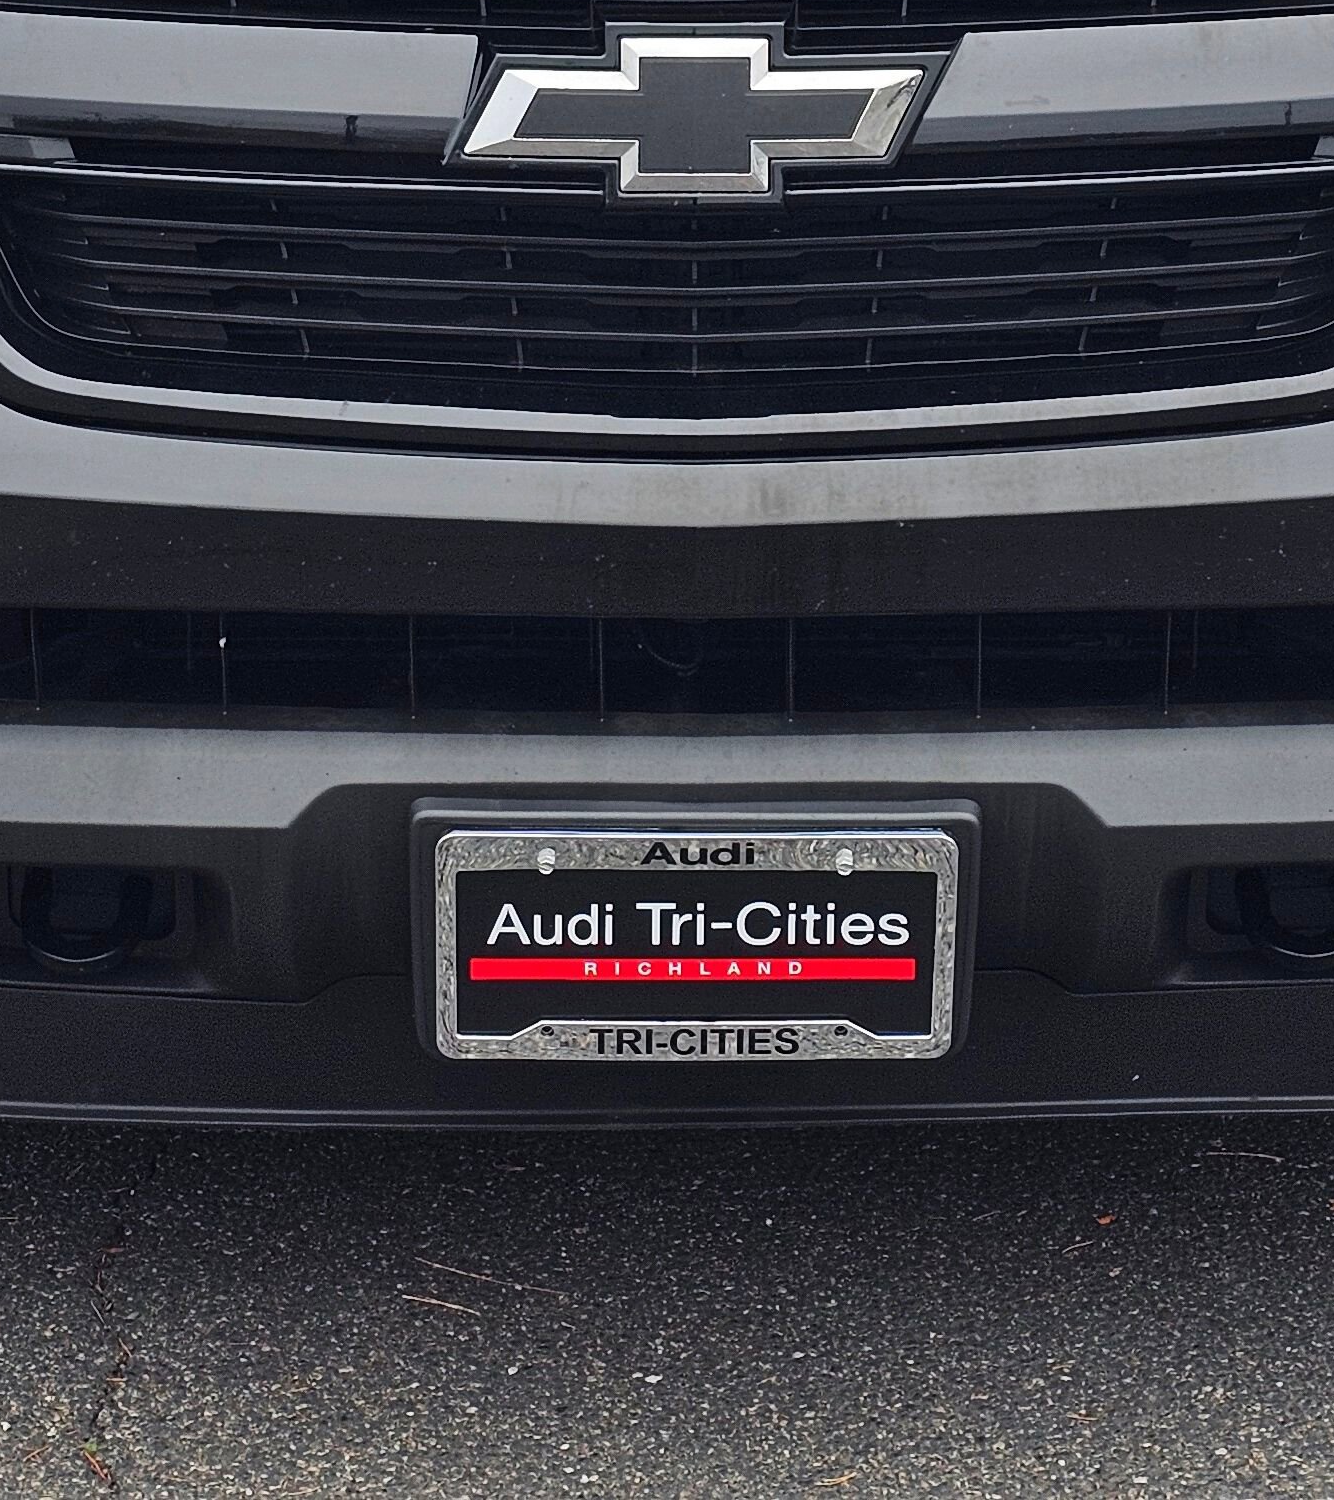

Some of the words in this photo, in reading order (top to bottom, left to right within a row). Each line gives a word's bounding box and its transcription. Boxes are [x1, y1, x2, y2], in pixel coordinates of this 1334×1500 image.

[640, 841, 756, 866] Audi
[486, 903, 614, 946] Audi
[635, 901, 910, 946] Tri-Cities
[584, 961, 803, 976] RICHLAND
[589, 1027, 800, 1056] TRI-CITIES
